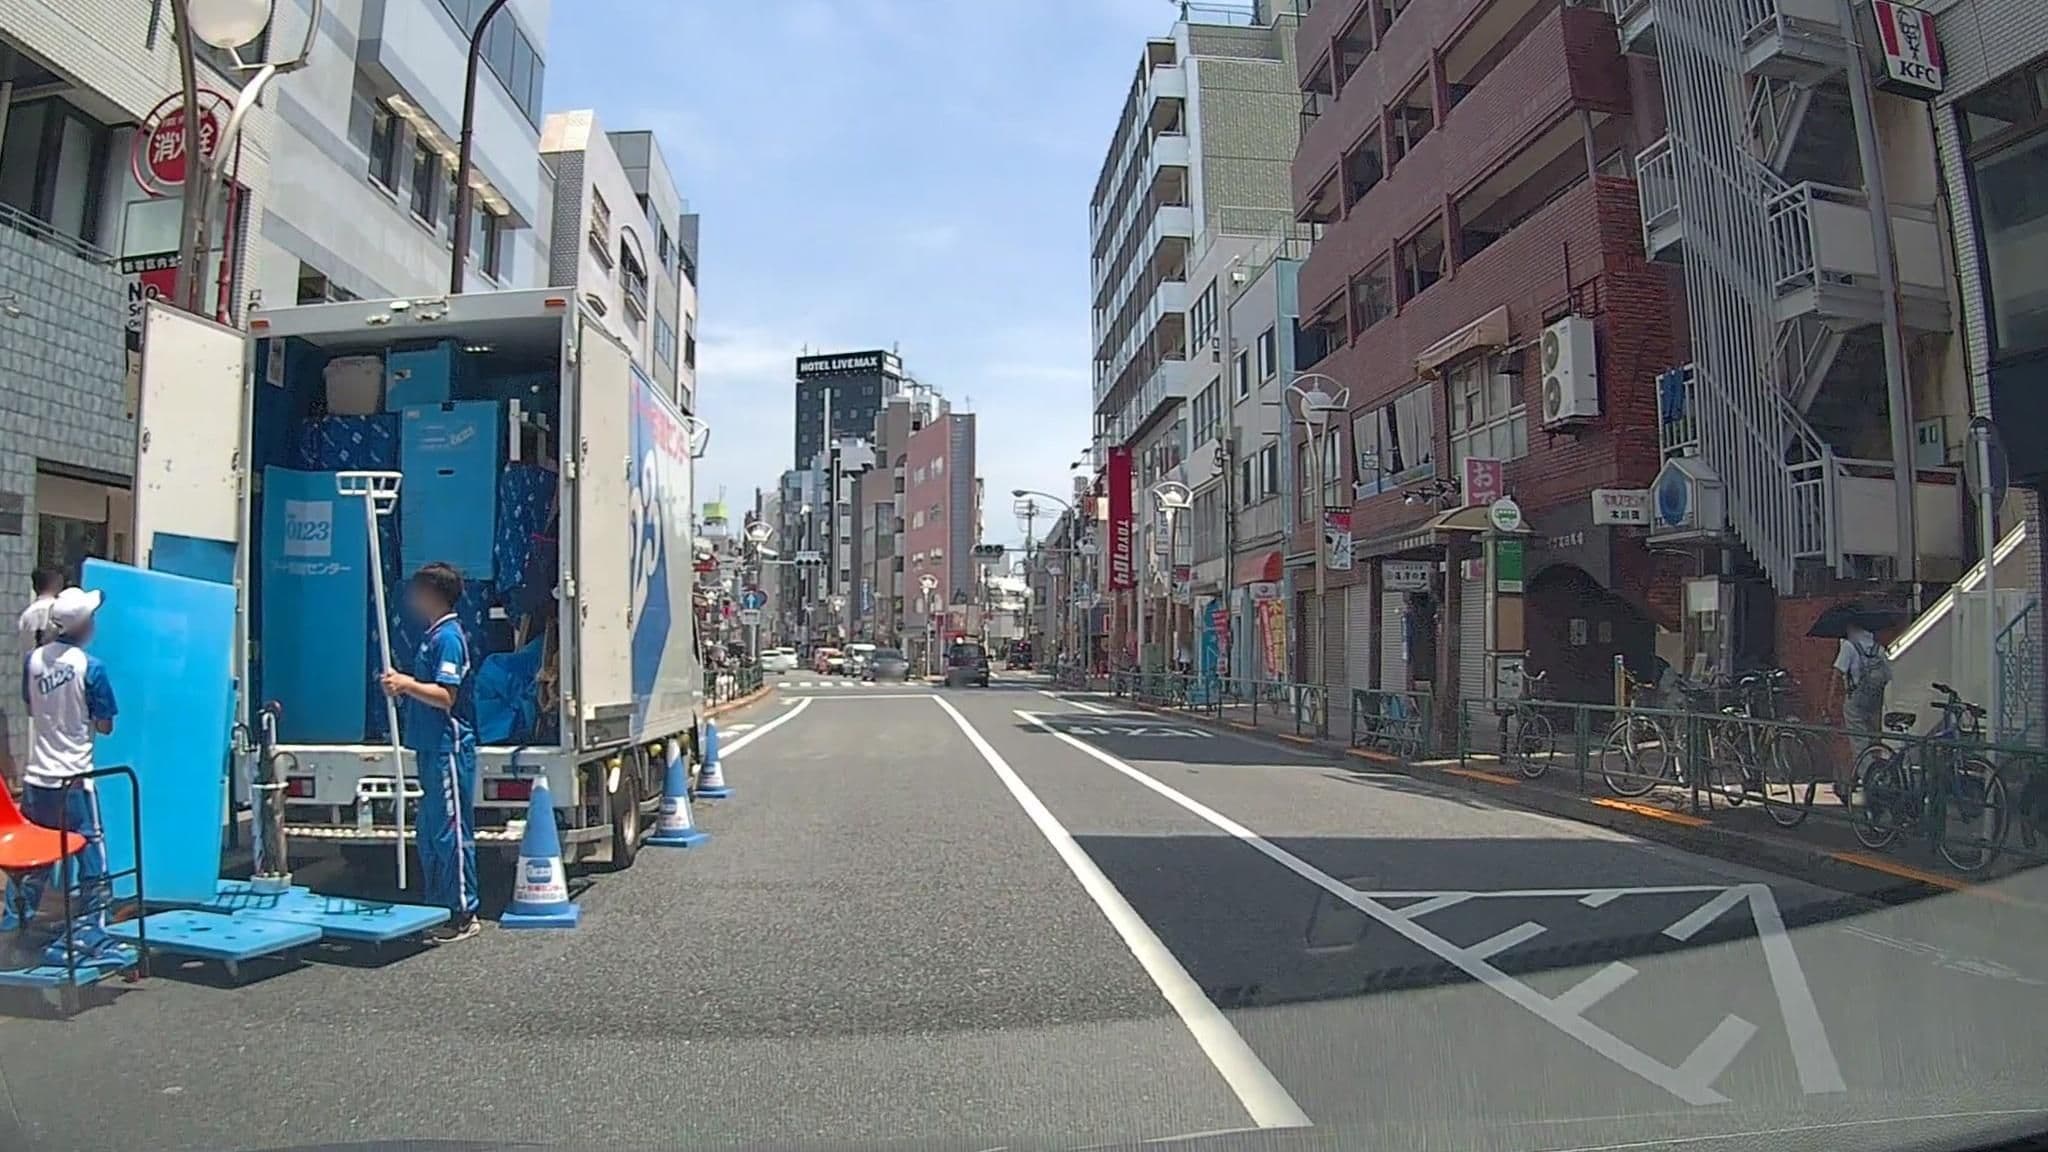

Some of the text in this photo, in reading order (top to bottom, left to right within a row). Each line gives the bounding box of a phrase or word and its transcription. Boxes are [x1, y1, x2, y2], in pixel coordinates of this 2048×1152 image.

[1898, 59, 1936, 84] KFC
[800, 360, 831, 372] HOTEL
[831, 356, 878, 369] LIVEMAX
[287, 521, 330, 541] 0123
[38, 664, 75, 695] 0123
